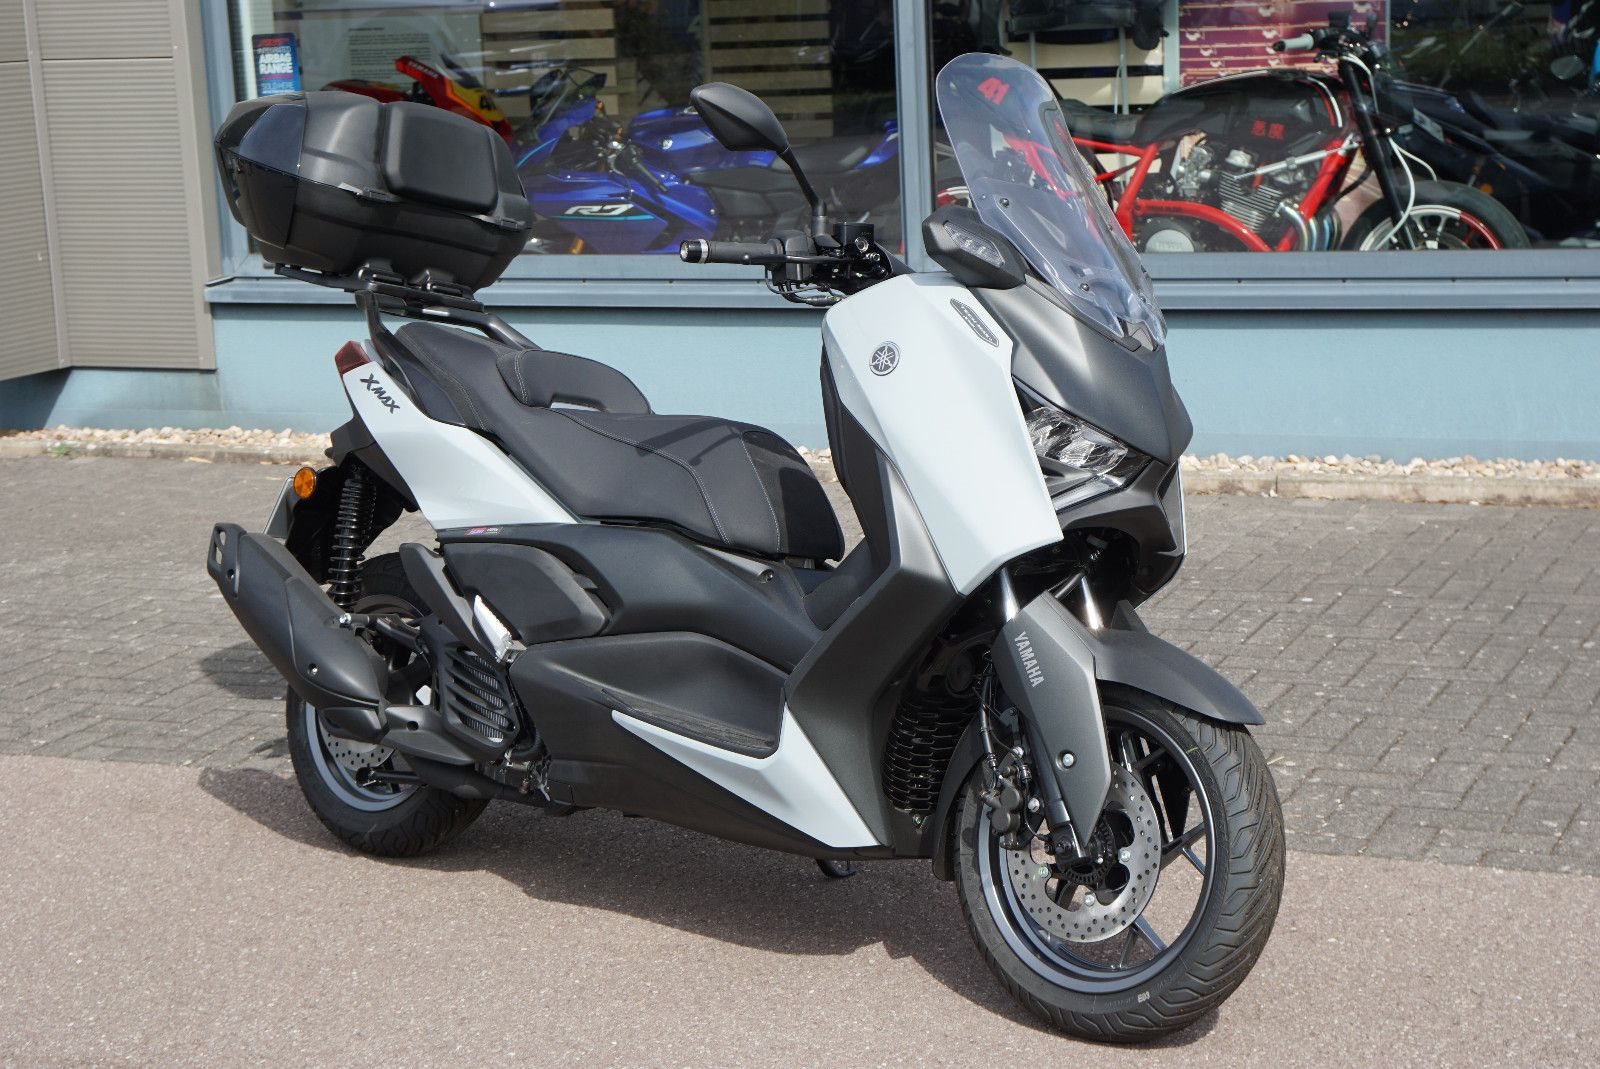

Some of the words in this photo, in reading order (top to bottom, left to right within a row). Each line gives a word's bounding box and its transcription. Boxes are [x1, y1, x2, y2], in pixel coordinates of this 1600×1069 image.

[259, 53, 292, 64] AIRBAG
[259, 63, 293, 74] RANGE
[564, 204, 634, 216] R7
[1014, 630, 1045, 688] YAMAHA
